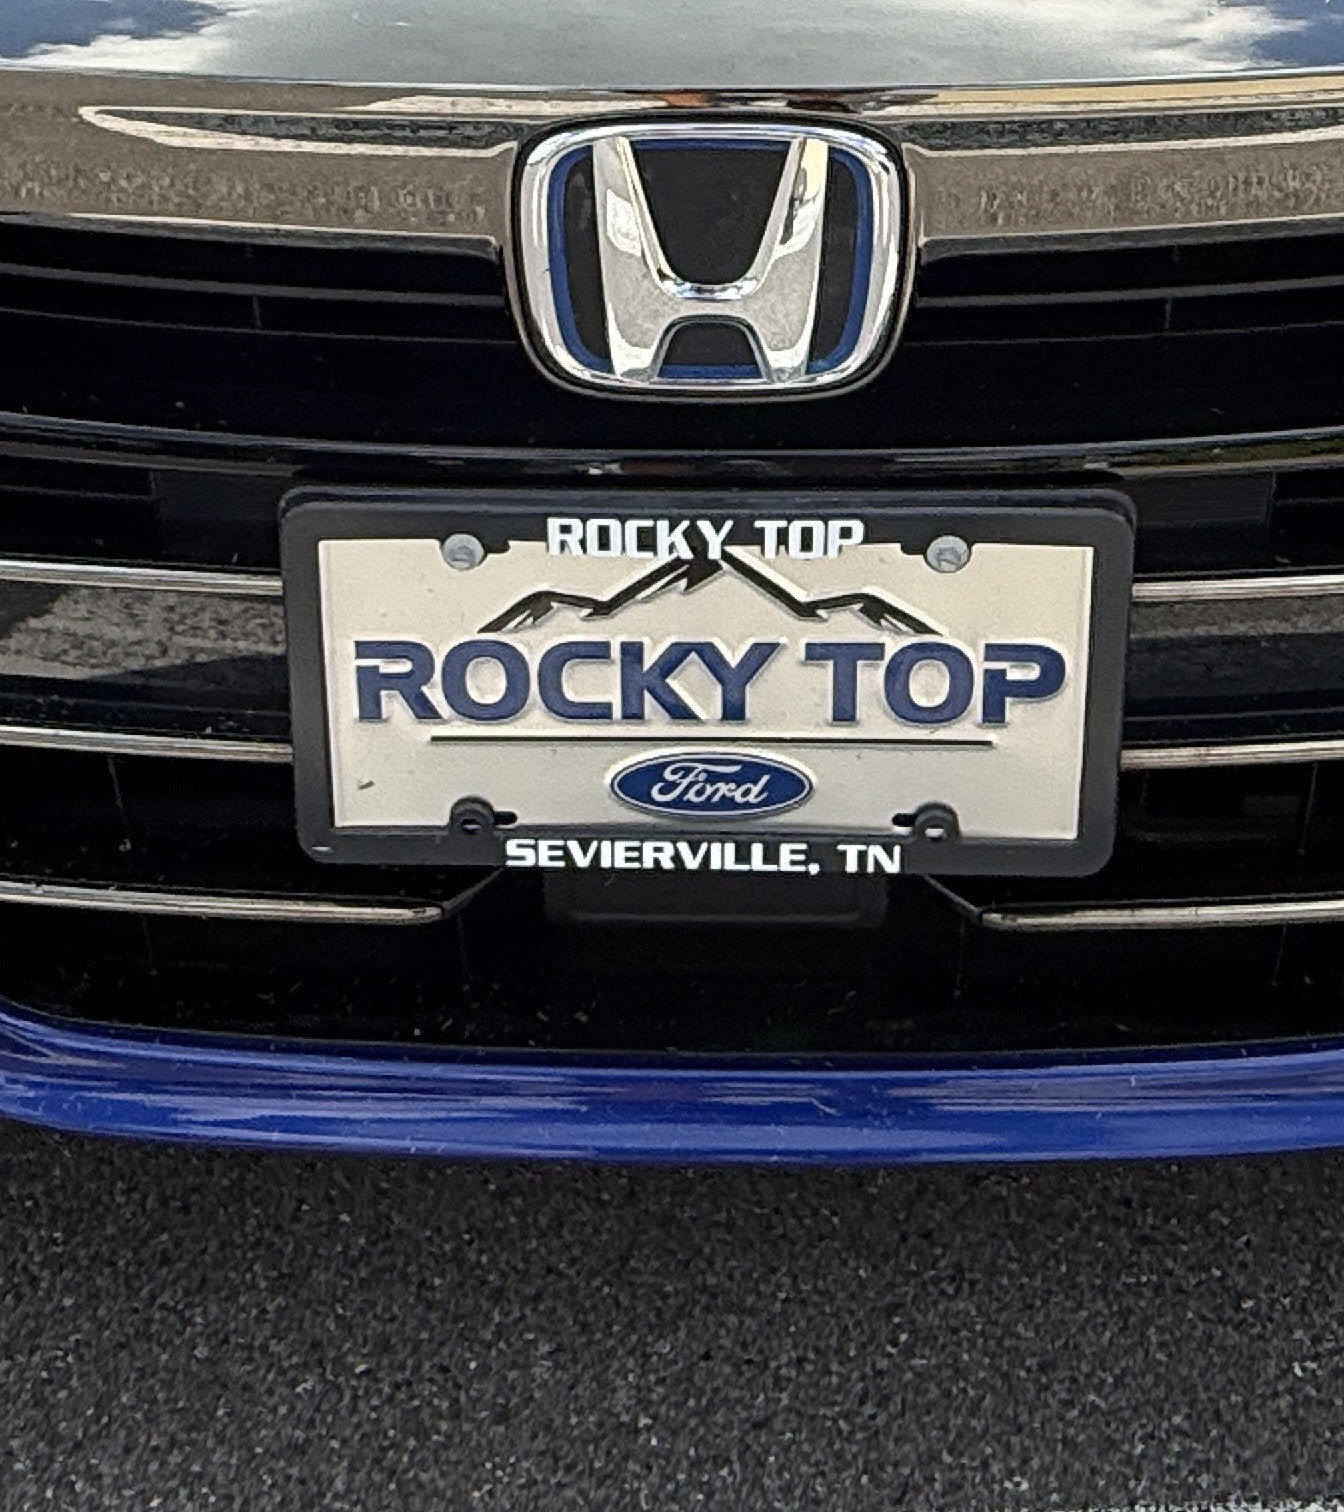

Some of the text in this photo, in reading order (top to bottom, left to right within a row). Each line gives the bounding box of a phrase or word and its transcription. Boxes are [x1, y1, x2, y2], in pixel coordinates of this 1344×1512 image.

[547, 517, 864, 561] ROCKY TOP
[355, 639, 1067, 727] ROCKY TOP
[651, 763, 768, 808] Ford
[506, 838, 901, 876] SEVIERVILLE, TN
